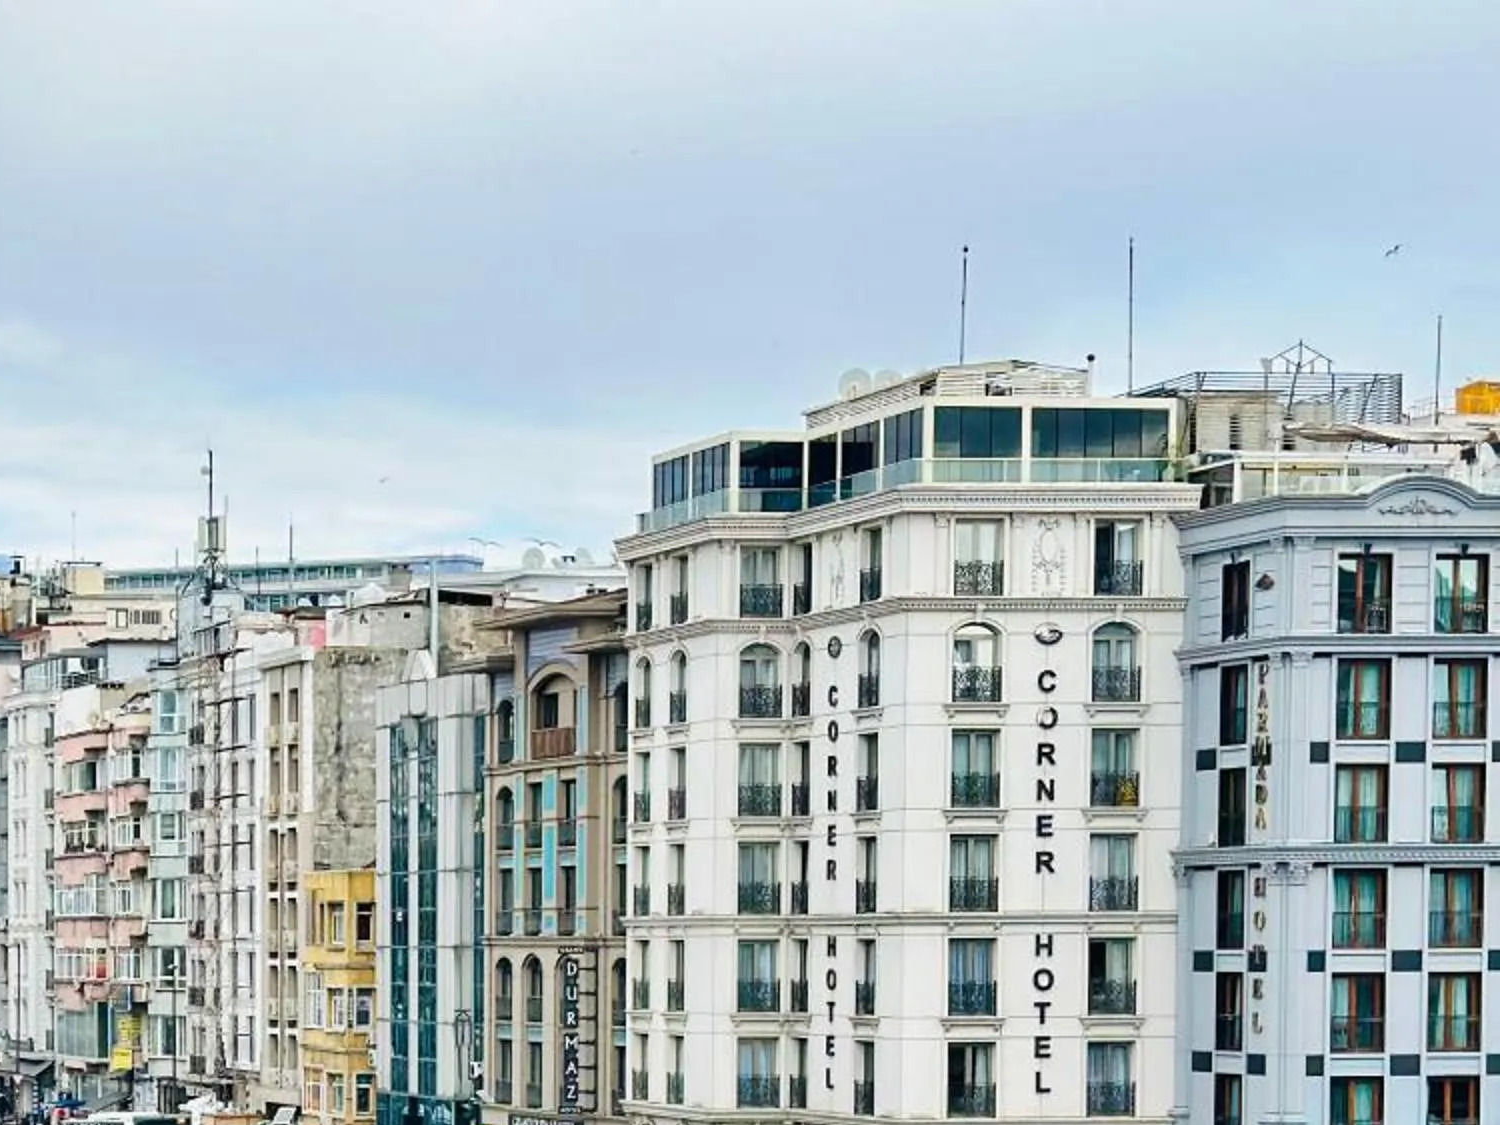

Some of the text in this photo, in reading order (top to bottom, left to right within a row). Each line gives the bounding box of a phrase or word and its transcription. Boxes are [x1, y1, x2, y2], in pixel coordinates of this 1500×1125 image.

[824, 684, 839, 1090] CORNER HOTEL
[1032, 669, 1059, 1094] CORNER HOTEL
[1251, 877, 1268, 1035] HOTEL
[565, 961, 577, 1099] DURMAZ
